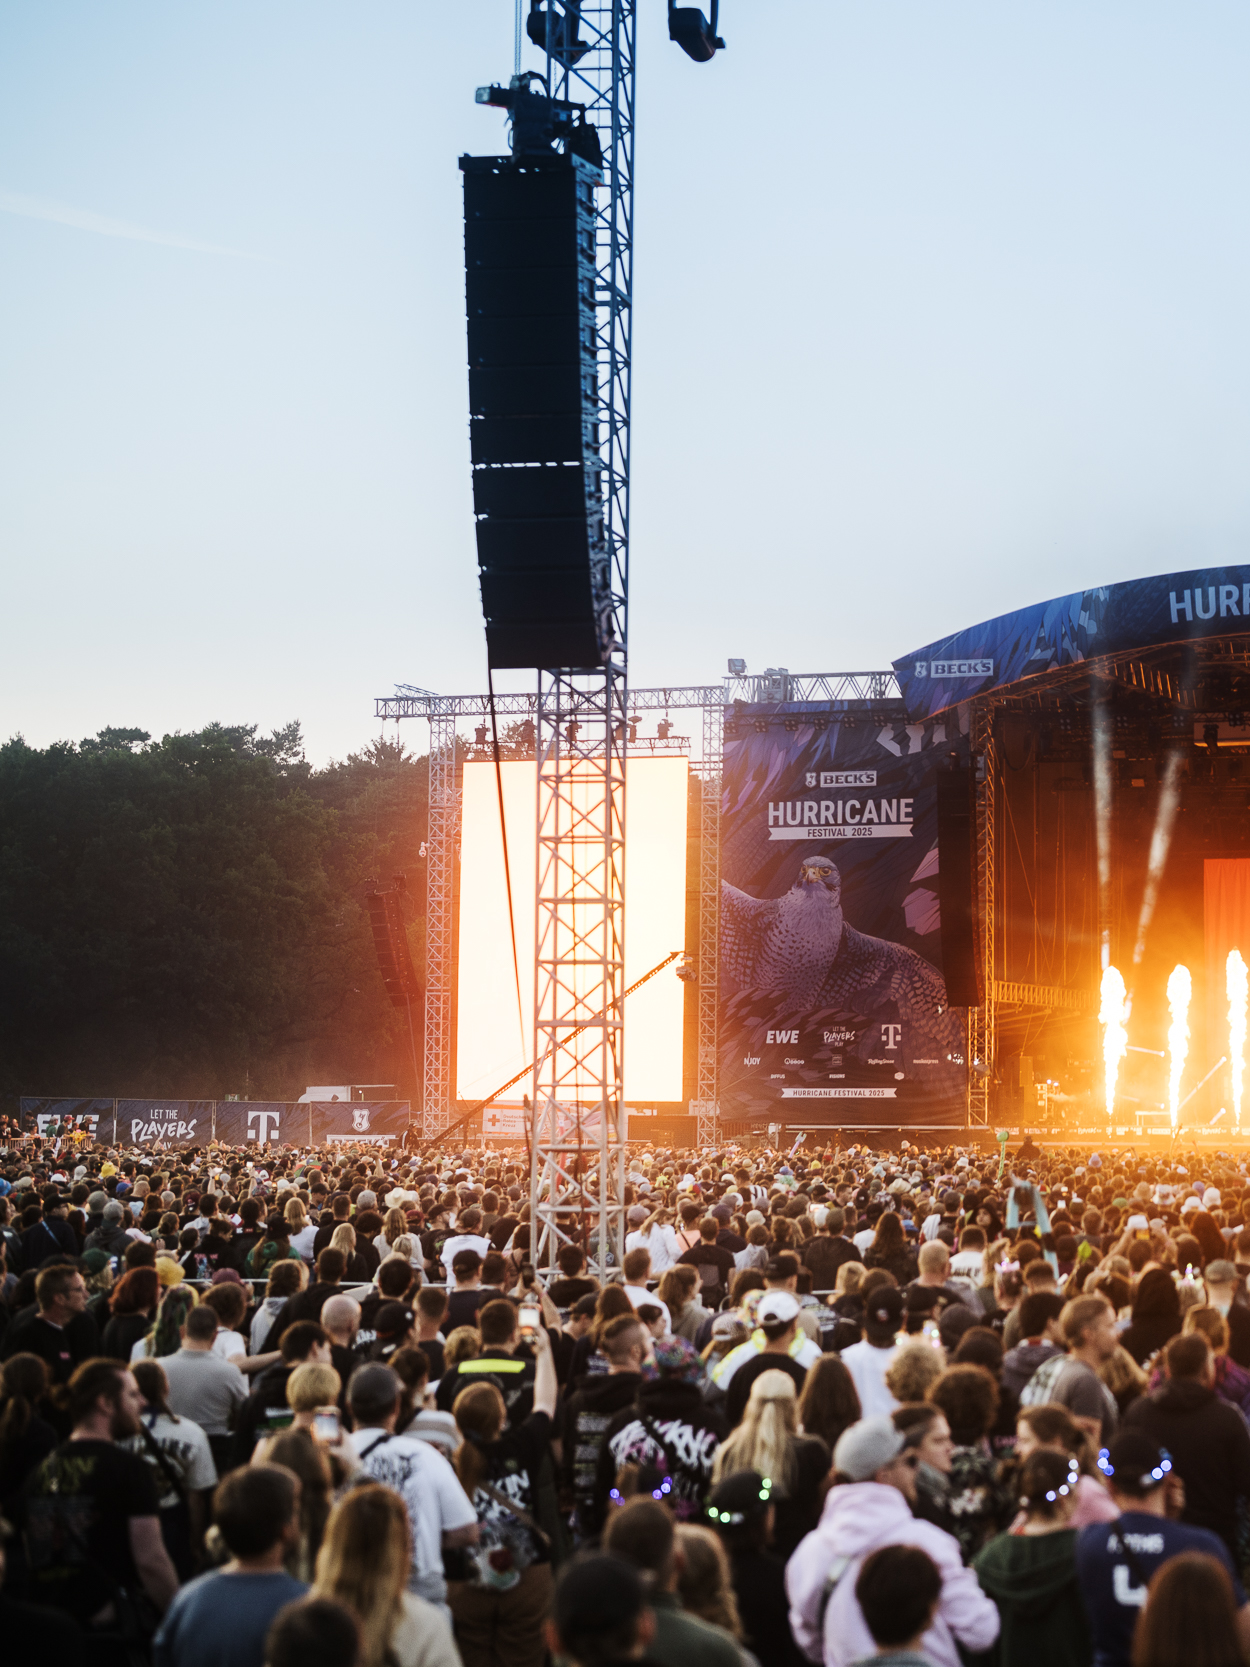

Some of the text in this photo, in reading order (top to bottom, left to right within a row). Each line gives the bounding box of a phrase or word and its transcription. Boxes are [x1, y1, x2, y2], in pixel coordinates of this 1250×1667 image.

[933, 661, 992, 675] BECK'S
[822, 772, 875, 786] BECK'S
[768, 798, 914, 826] HURRICANE
[807, 827, 873, 838] FESTIVAL 2025
[766, 1030, 800, 1044] EWE
[823, 1031, 856, 1043] PLAYERS
[881, 1024, 902, 1049] T
[793, 1089, 885, 1097] HURRICANE FESTIVAL 2025
[150, 1109, 178, 1119] LET THE
[130, 1118, 198, 1143] PLAYERS
